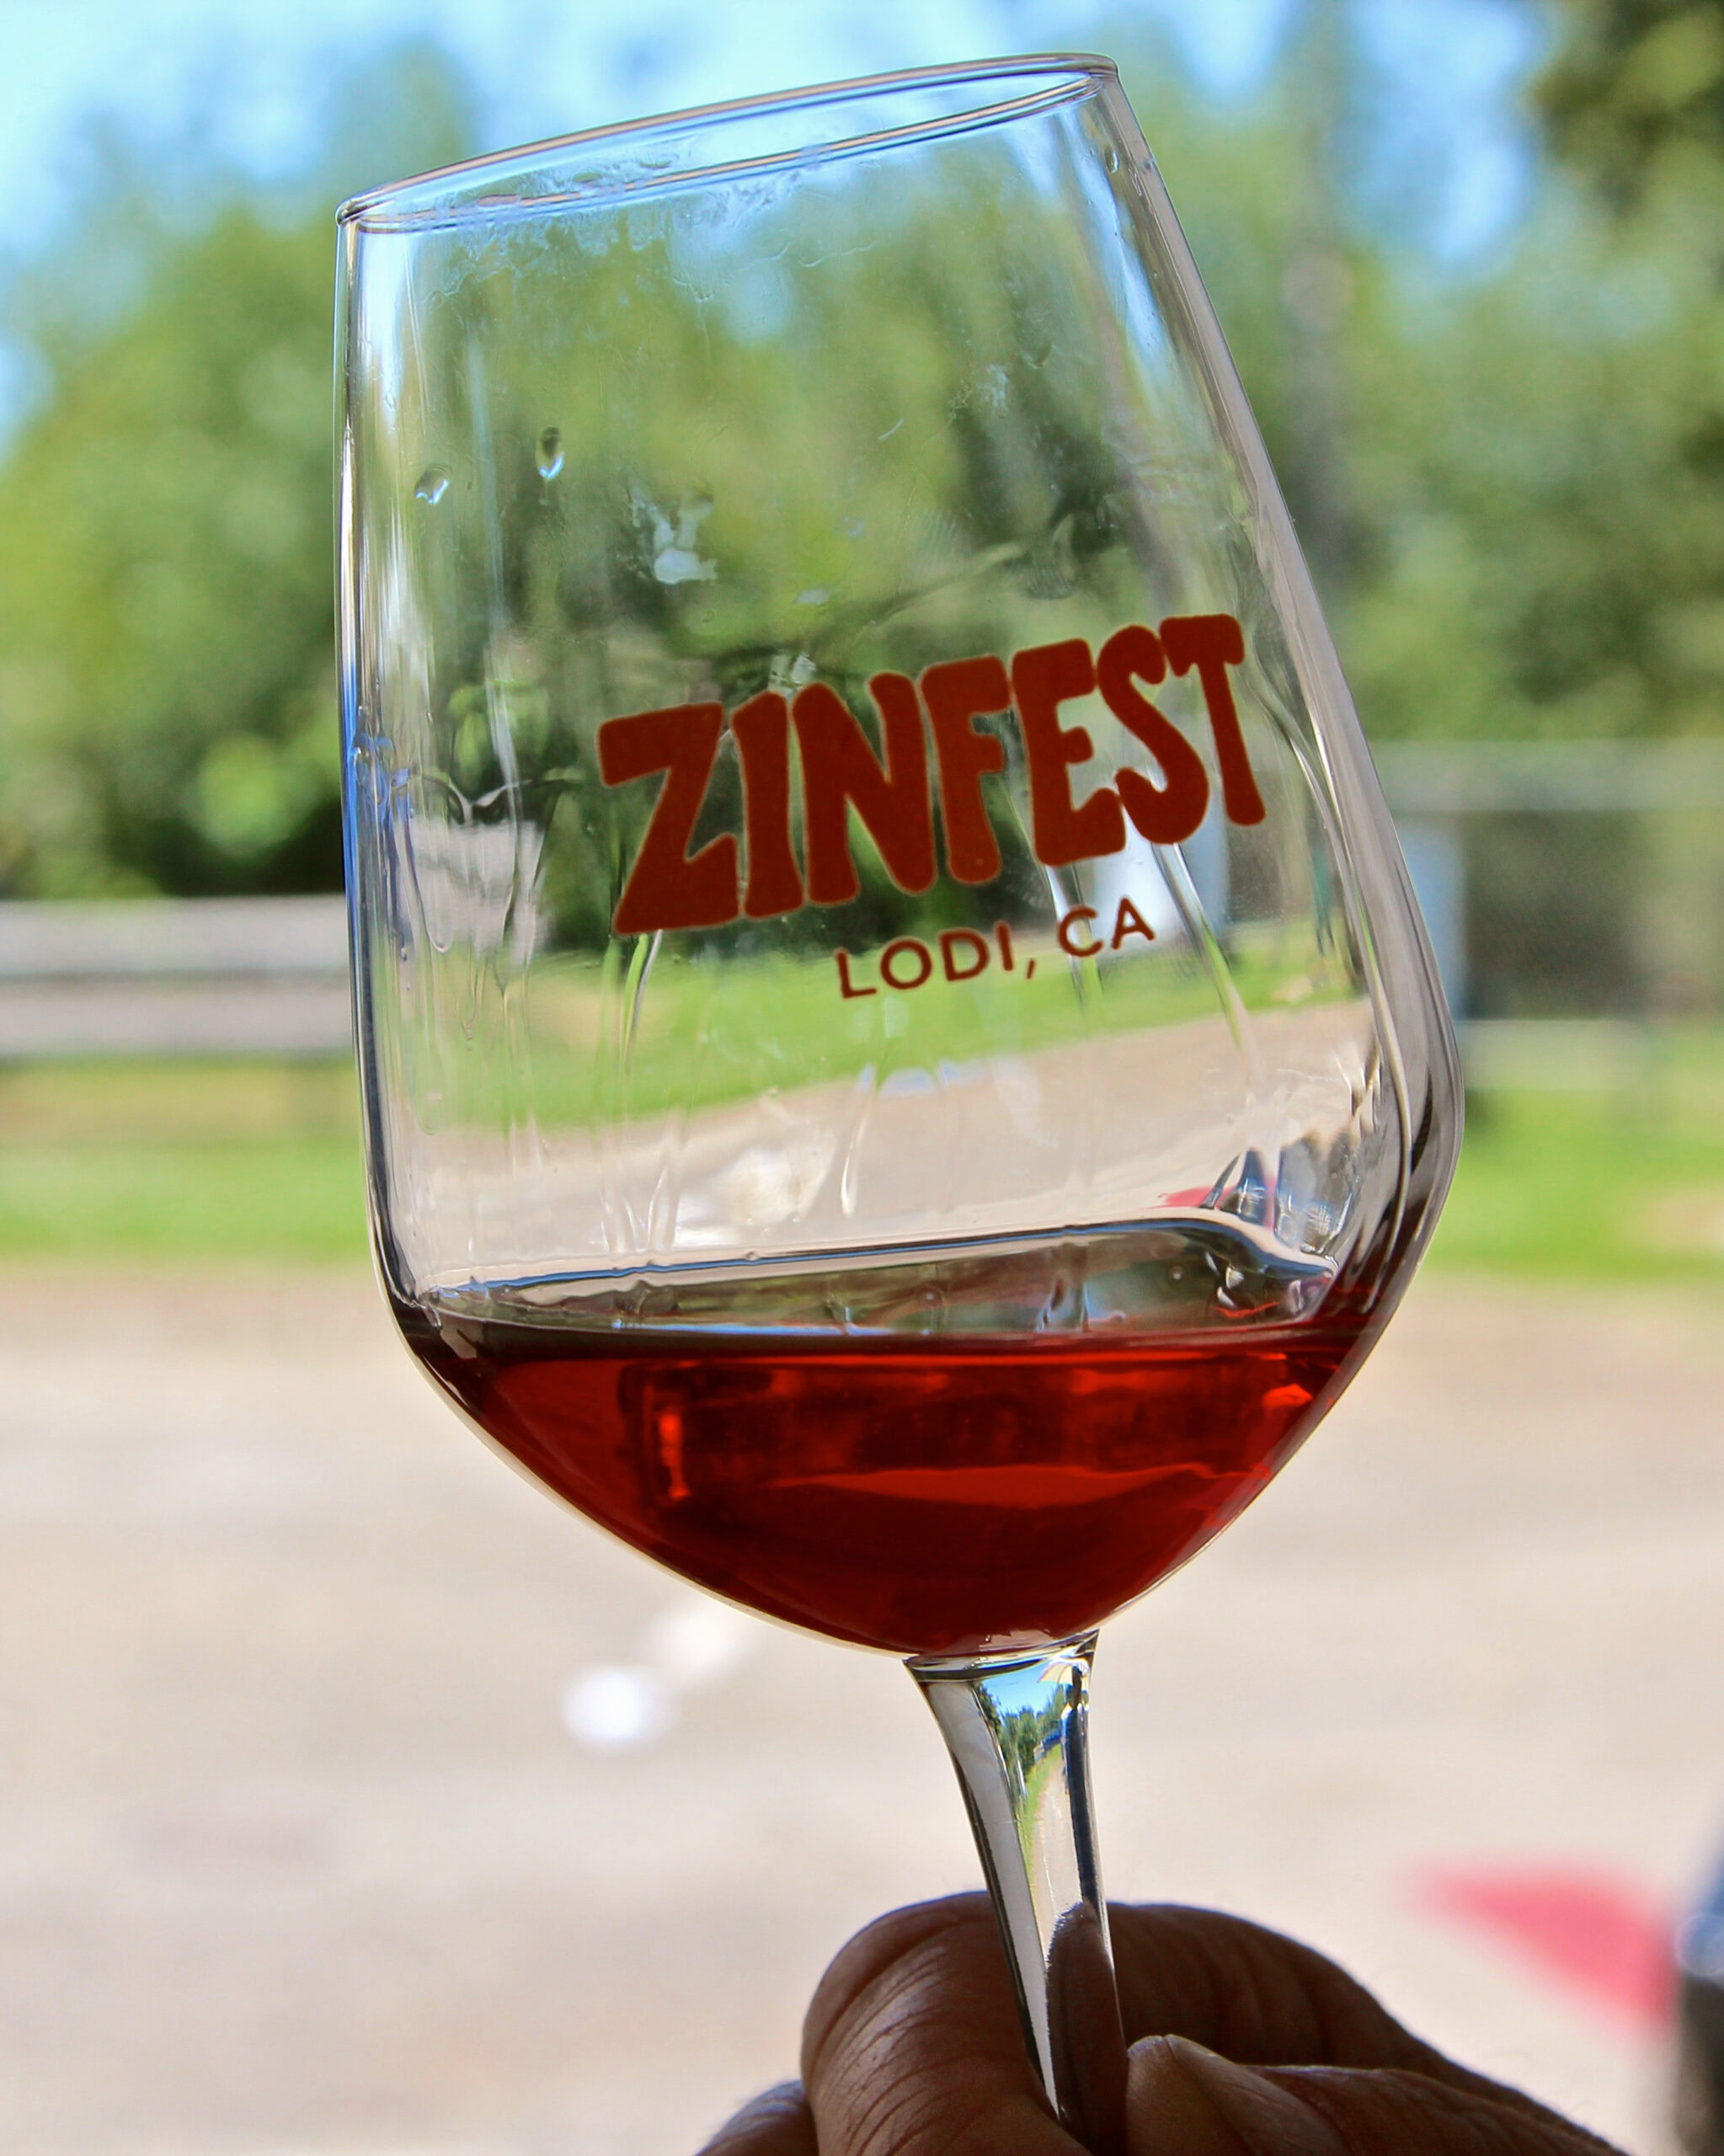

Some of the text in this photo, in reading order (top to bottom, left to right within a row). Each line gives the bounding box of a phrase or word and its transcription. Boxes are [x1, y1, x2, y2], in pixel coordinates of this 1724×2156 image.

[597, 613, 1267, 935] ZINFEST
[836, 898, 1155, 999] LODI, CA
